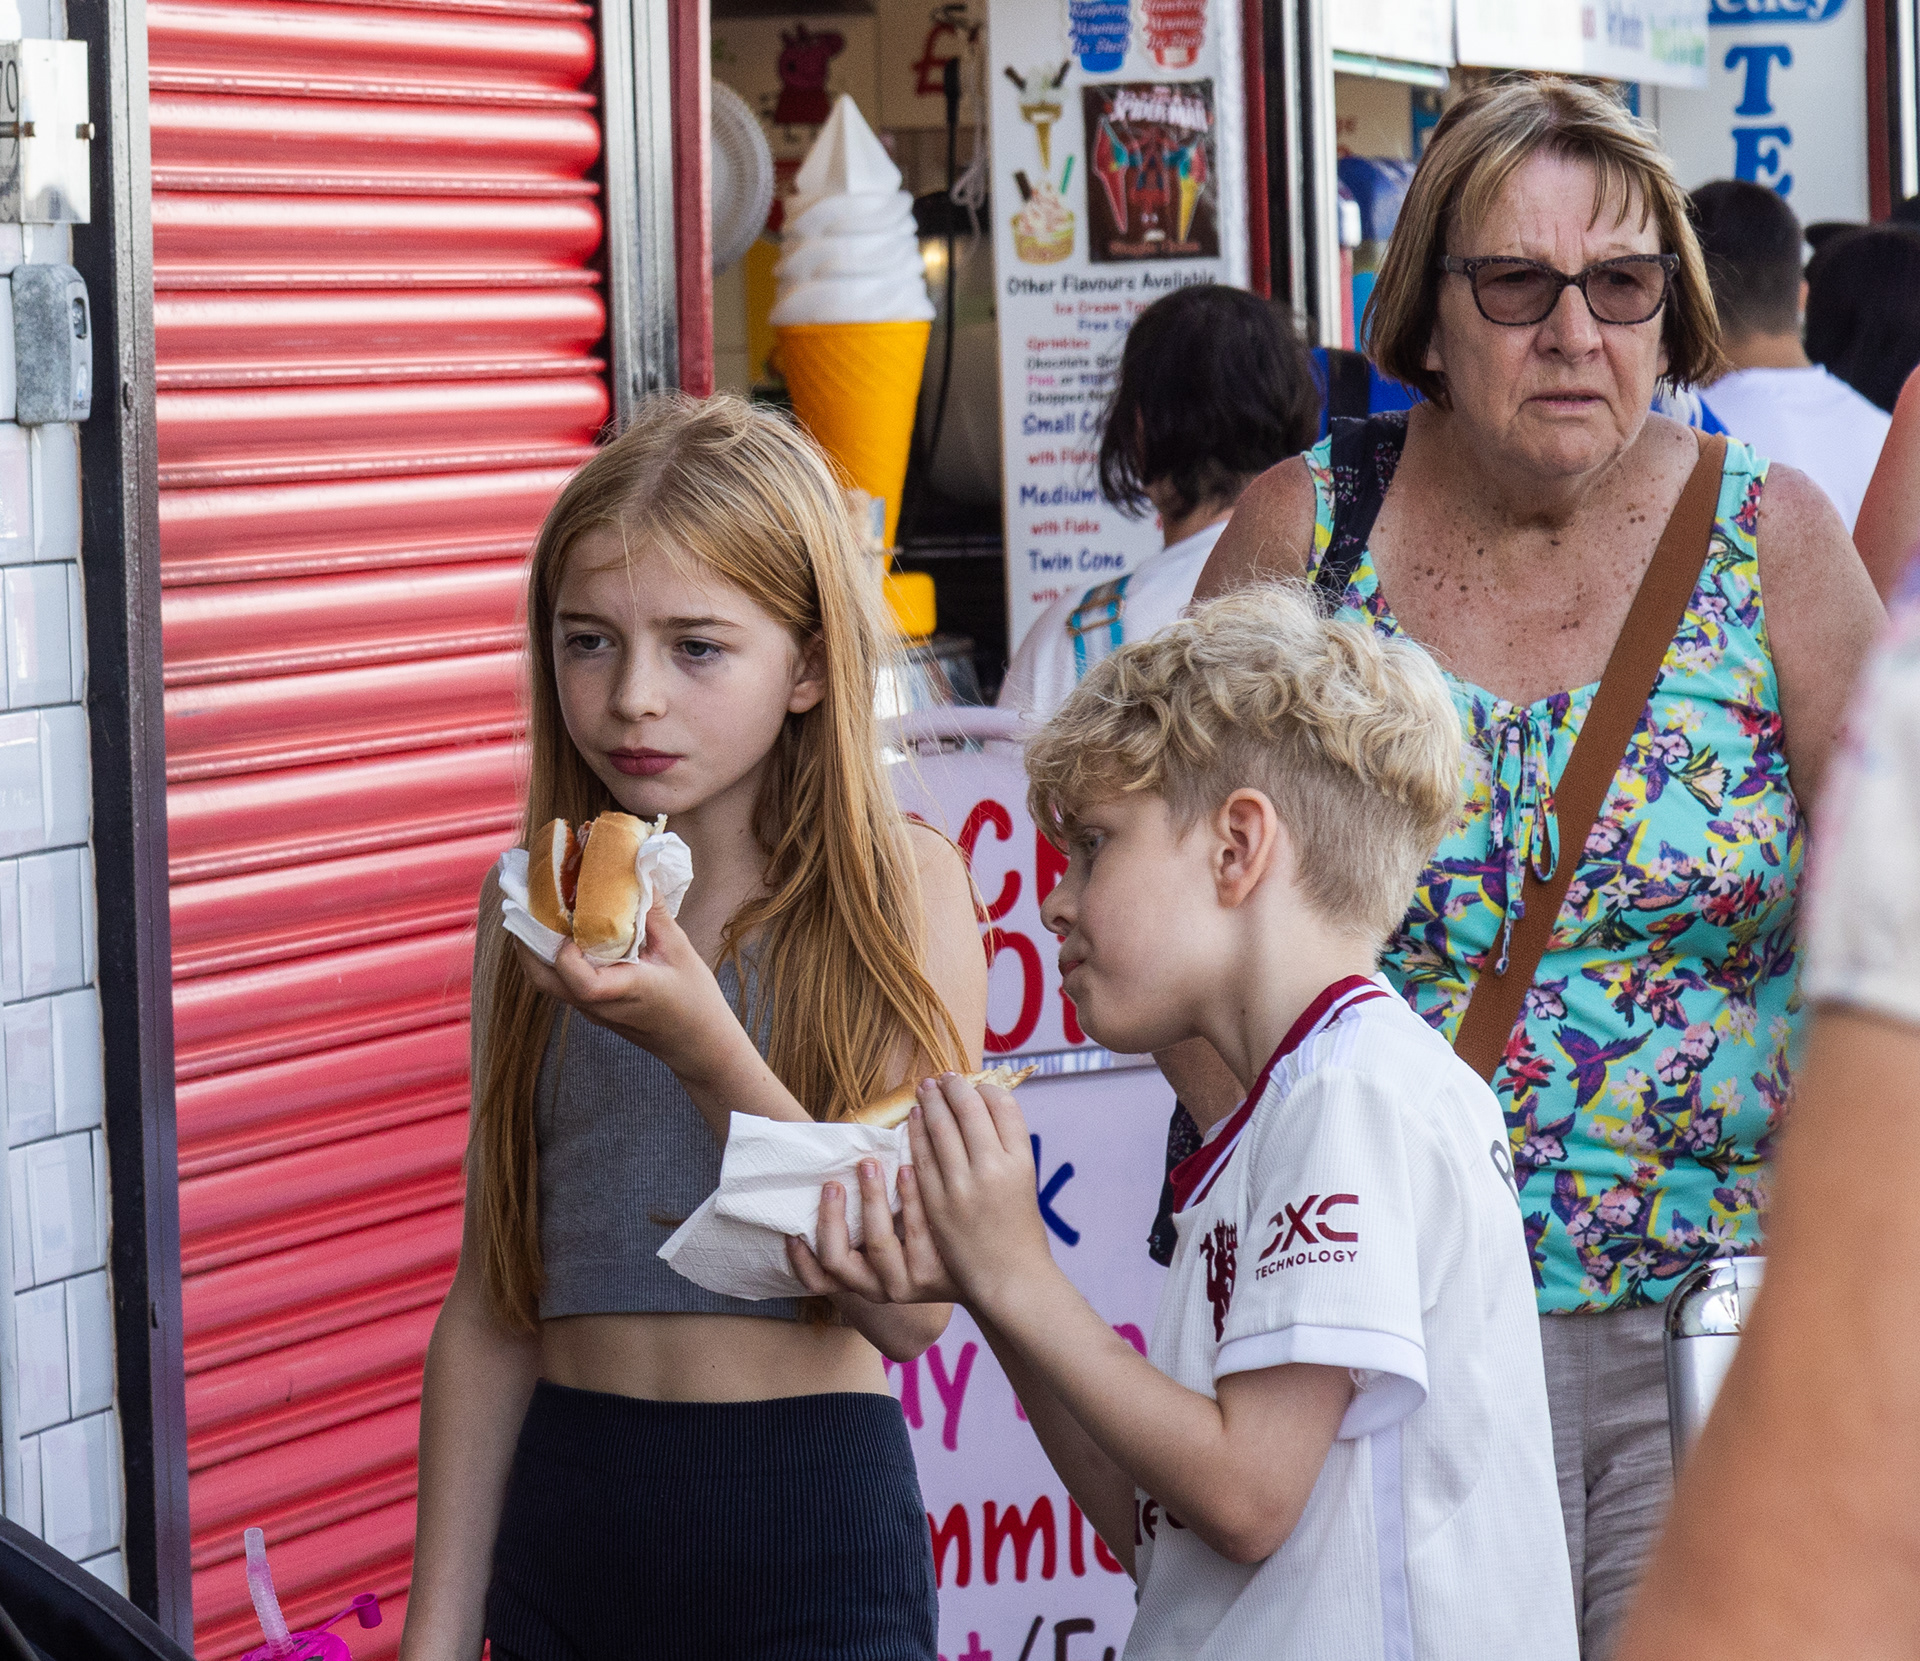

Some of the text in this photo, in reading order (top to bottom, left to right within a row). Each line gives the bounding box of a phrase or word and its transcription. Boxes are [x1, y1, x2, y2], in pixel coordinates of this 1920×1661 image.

[1007, 276, 1056, 296] Other
[1062, 273, 1135, 293] Flavours
[1054, 302, 1074, 315] Ice
[1078, 300, 1121, 314] Cream
[1078, 320, 1109, 332] Free
[1026, 336, 1090, 351] Sprinkles
[1026, 356, 1090, 370] Chocolate
[1027, 374, 1055, 386] Pink
[1061, 376, 1074, 385] or
[1028, 391, 1084, 406] Chopped
[1023, 412, 1076, 435] Small
[1028, 447, 1099, 465] with Flake
[1020, 485, 1098, 506] Medium
[1031, 518, 1100, 535] with Flake
[1029, 549, 1126, 573] Twin Cone
[1255, 1249, 1358, 1281] TECHNOLOGY
